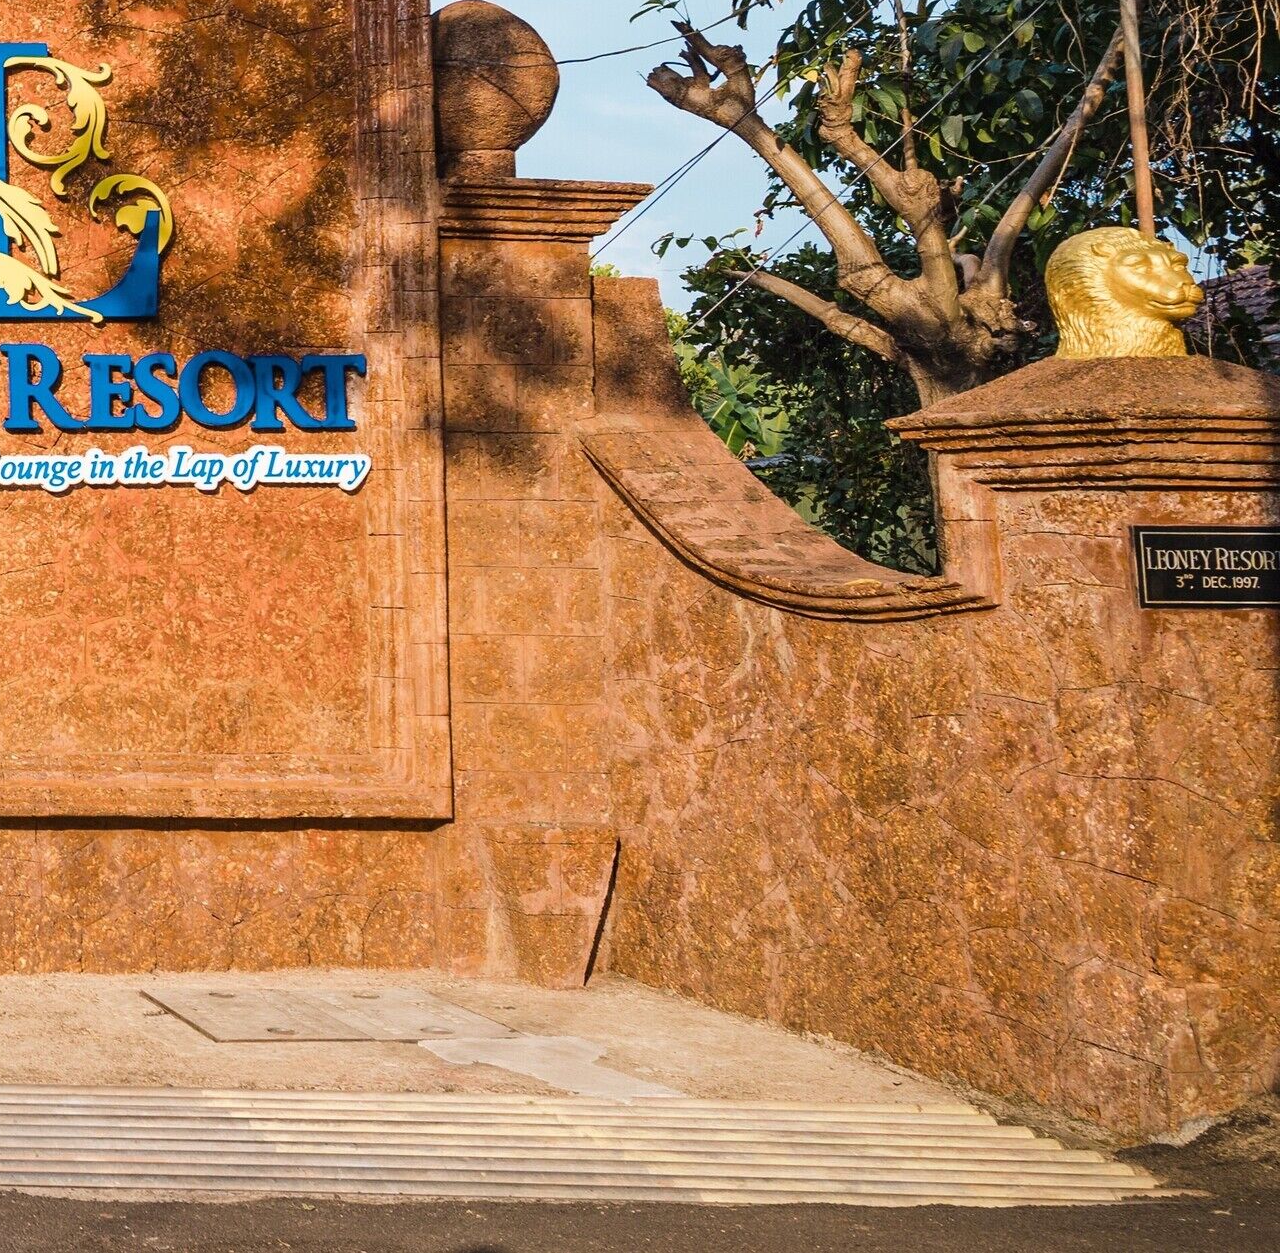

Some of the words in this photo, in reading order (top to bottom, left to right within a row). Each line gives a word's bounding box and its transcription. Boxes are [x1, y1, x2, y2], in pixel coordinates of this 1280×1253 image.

[89, 453, 115, 480] in
[124, 451, 163, 480] the
[171, 451, 225, 485] Lap
[232, 449, 264, 486] of
[265, 451, 366, 487] Luxury
[1145, 547, 1213, 570] LEONEY
